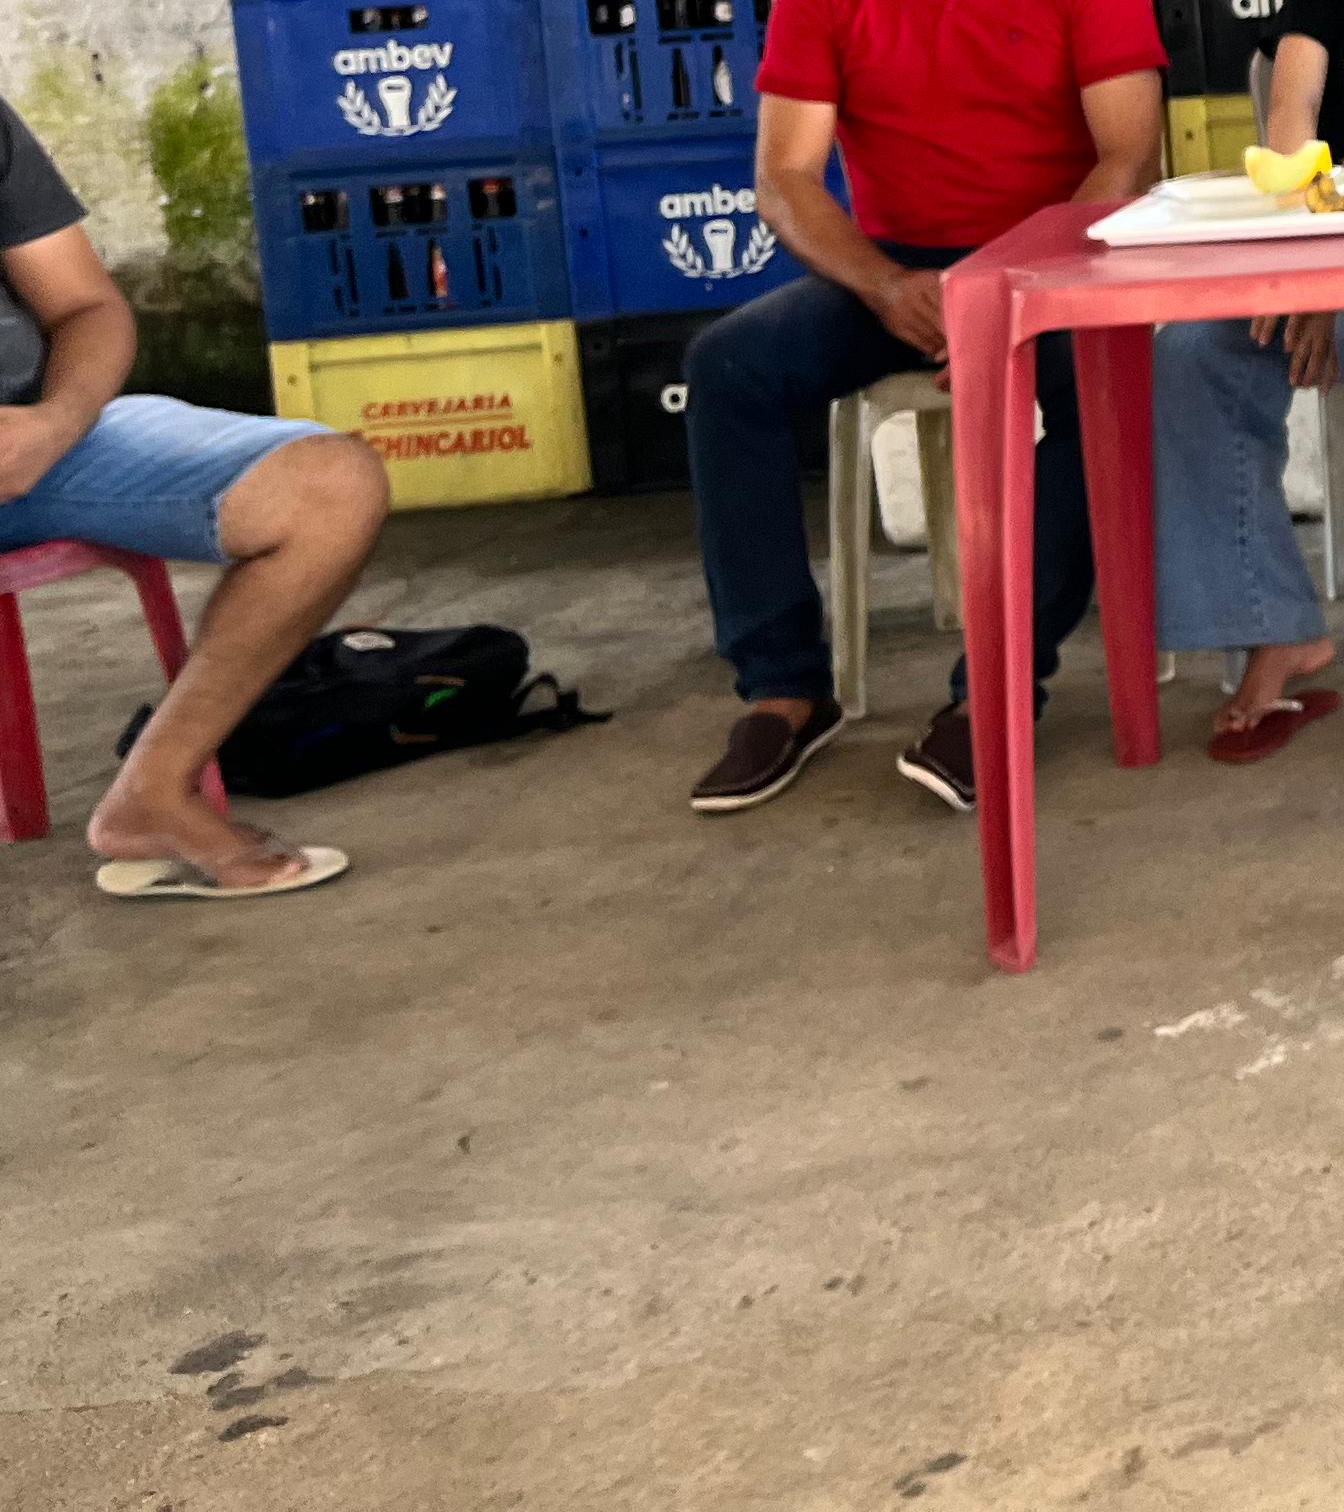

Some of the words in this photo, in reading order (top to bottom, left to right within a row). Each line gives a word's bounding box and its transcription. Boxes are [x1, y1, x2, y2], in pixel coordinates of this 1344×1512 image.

[332, 40, 454, 74] ambev
[659, 183, 757, 220] ambe
[361, 392, 513, 420] CERVEJARIA
[355, 424, 533, 462] CHINCARIOL
